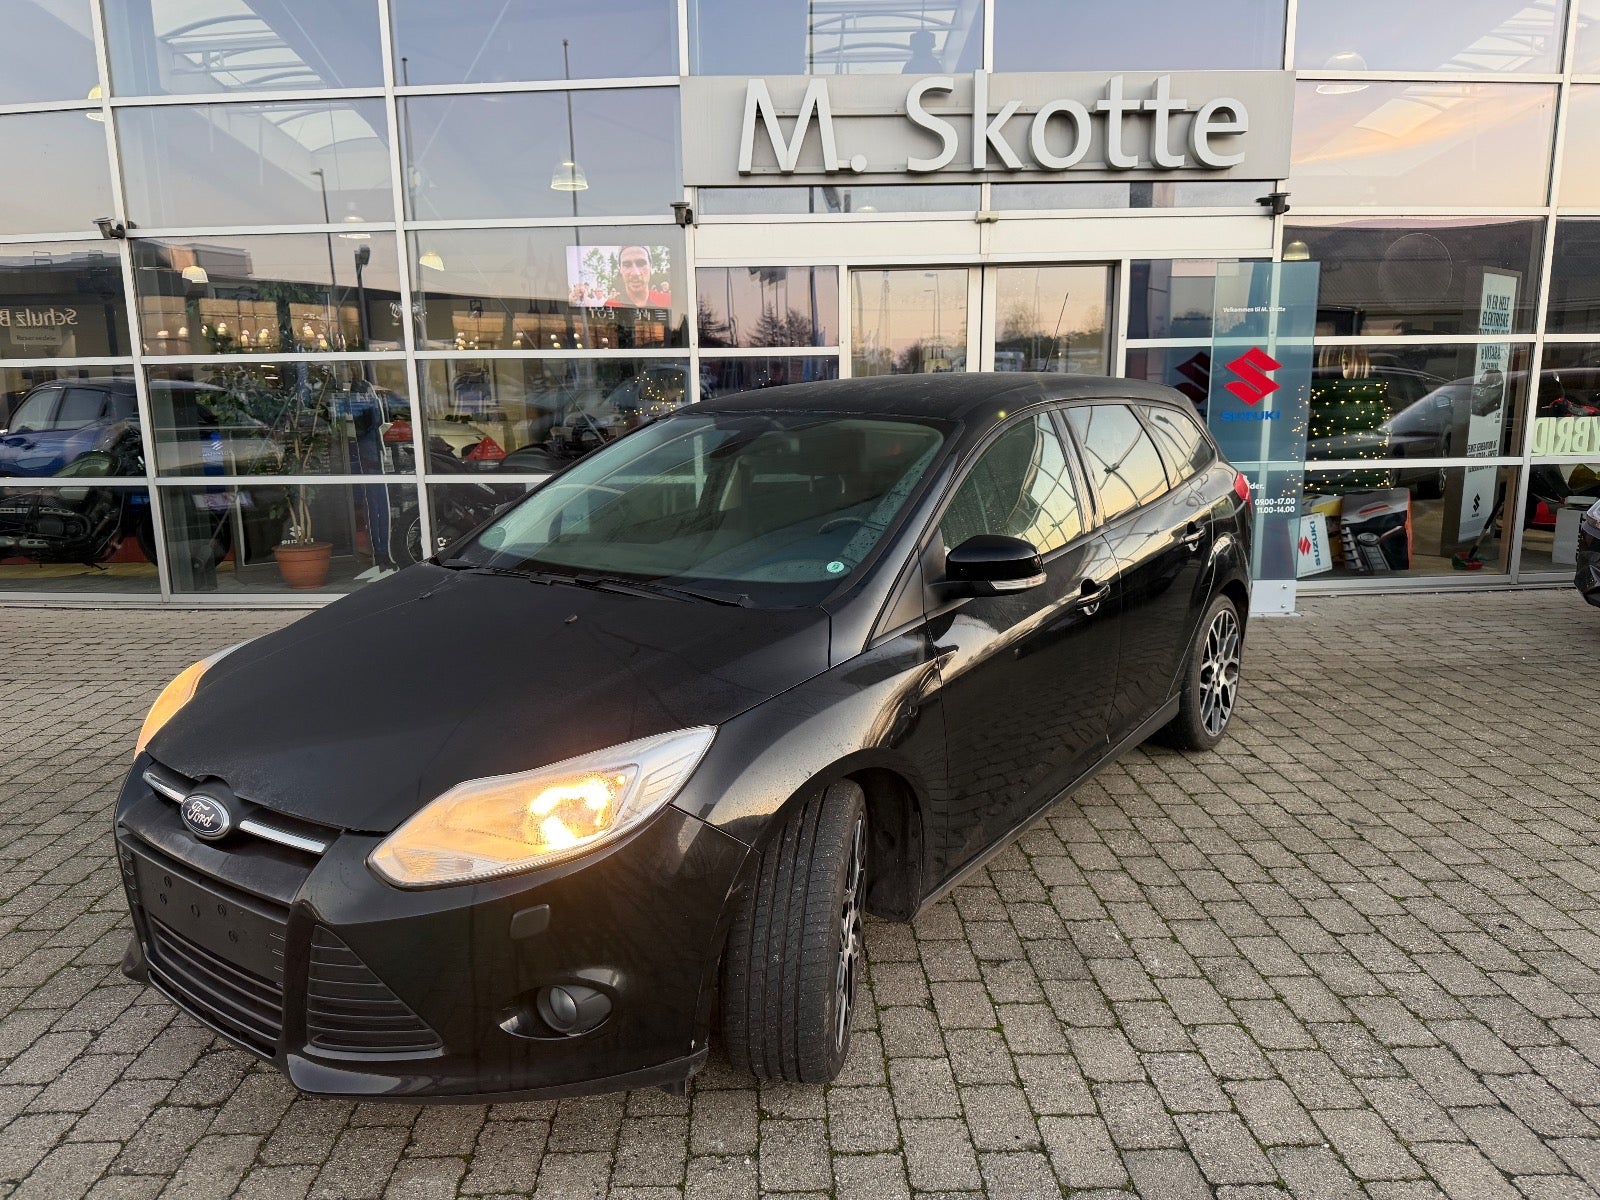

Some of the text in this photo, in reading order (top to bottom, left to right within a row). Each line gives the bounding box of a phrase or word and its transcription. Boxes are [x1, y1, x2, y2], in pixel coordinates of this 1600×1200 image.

[738, 69, 1248, 176] M. Skotte
[1222, 410, 1281, 421] SUZUKI
[1309, 520, 1321, 566] SUZUKI
[187, 800, 216, 828] Ford
